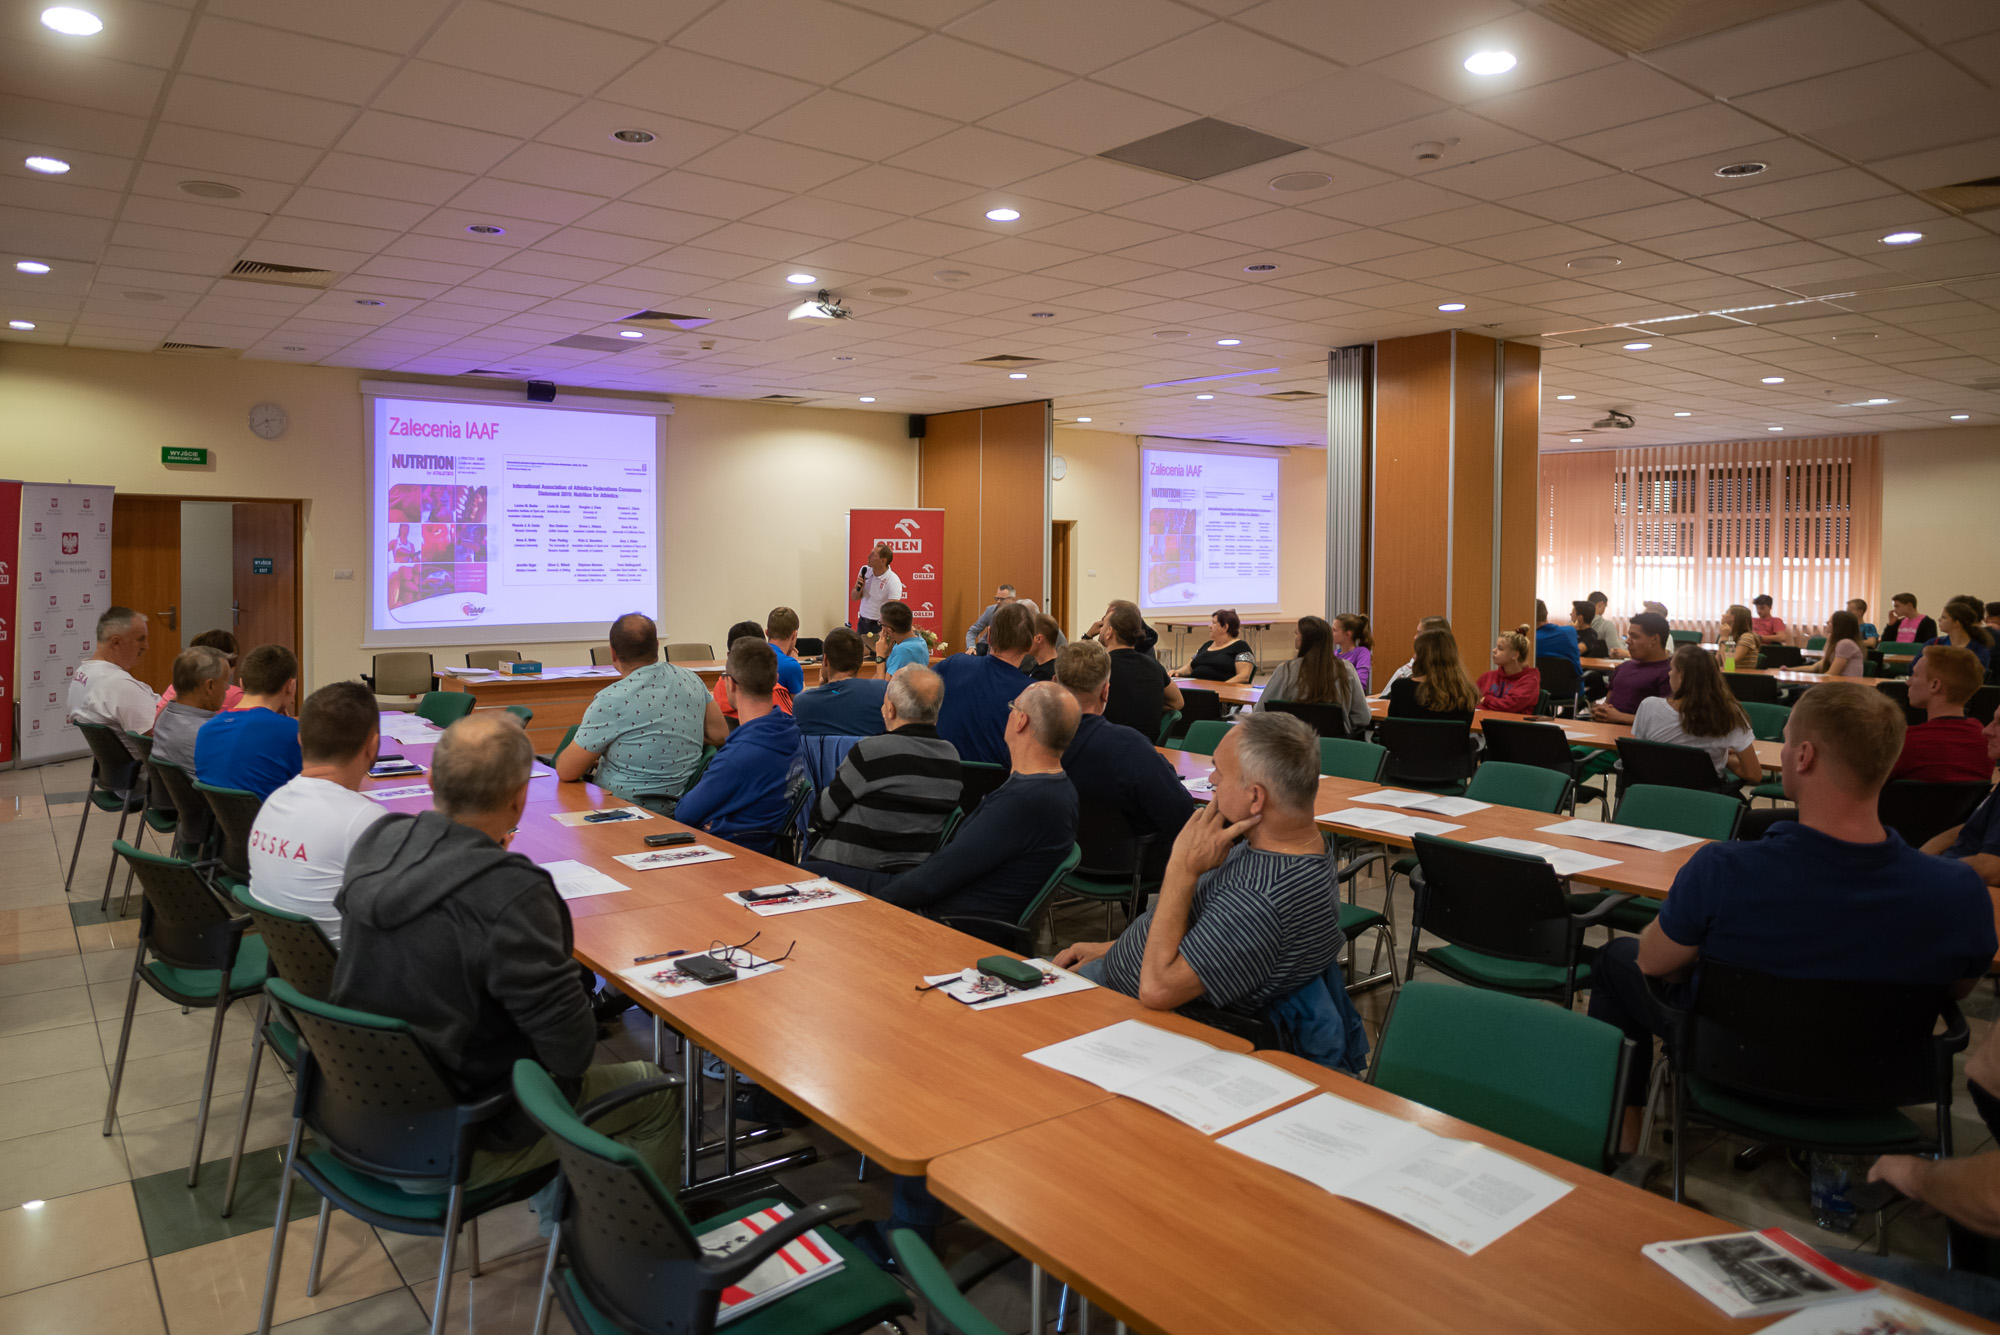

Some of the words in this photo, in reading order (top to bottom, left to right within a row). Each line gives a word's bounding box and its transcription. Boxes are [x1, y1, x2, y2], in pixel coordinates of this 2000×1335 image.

[389, 417, 461, 438] Zalecenia
[465, 421, 500, 440] IAAF
[392, 454, 454, 470] NUTRITION
[1150, 462, 1185, 477] Zalecenia
[1186, 464, 1203, 477] IAAF
[1151, 488, 1181, 498] NUTRITION
[250, 828, 308, 862] OLSKA
